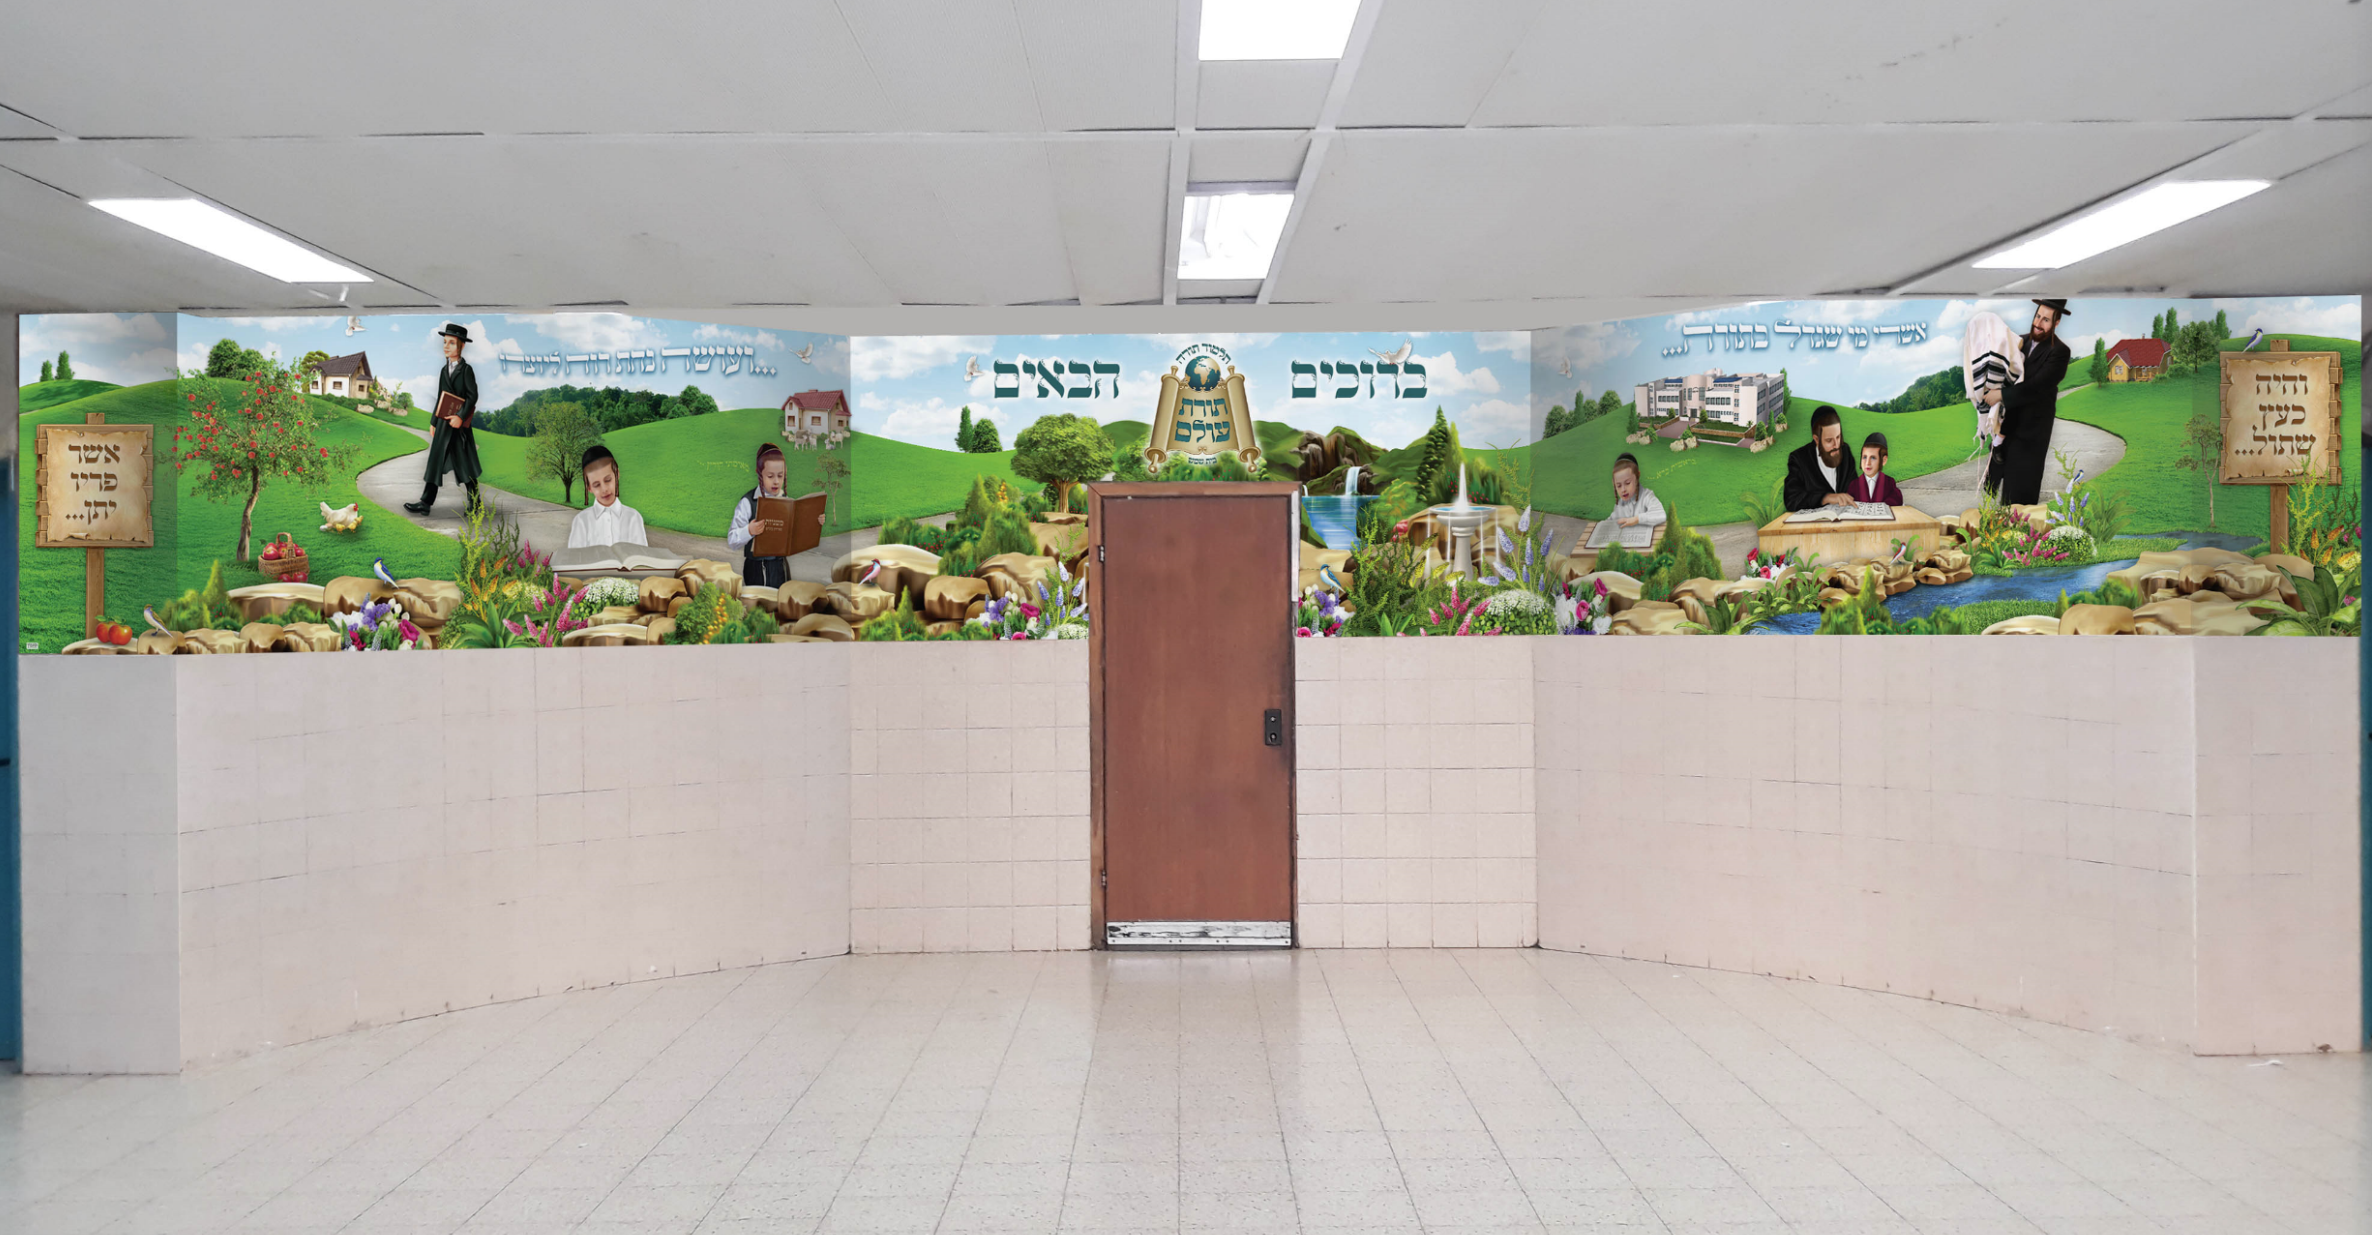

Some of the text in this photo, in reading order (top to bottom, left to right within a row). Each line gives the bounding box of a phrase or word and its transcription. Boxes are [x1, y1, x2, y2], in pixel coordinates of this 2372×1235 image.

[1774, 320, 1842, 349] שגדל
[1848, 325, 1868, 347] מי
[1873, 322, 1926, 345] אשרי
[499, 351, 560, 375] ליוצרו
[616, 348, 655, 373] נחת
[1175, 343, 1232, 365] תלמוד תורה
[993, 359, 1428, 399] ברוכים הבאים
[2255, 373, 2308, 395] והיה
[1178, 397, 1228, 417] תורת
[2258, 404, 2306, 431] כעץ
[1174, 420, 1230, 443] עולם
[68, 444, 120, 464] אשר
[70, 472, 118, 492] פריו
